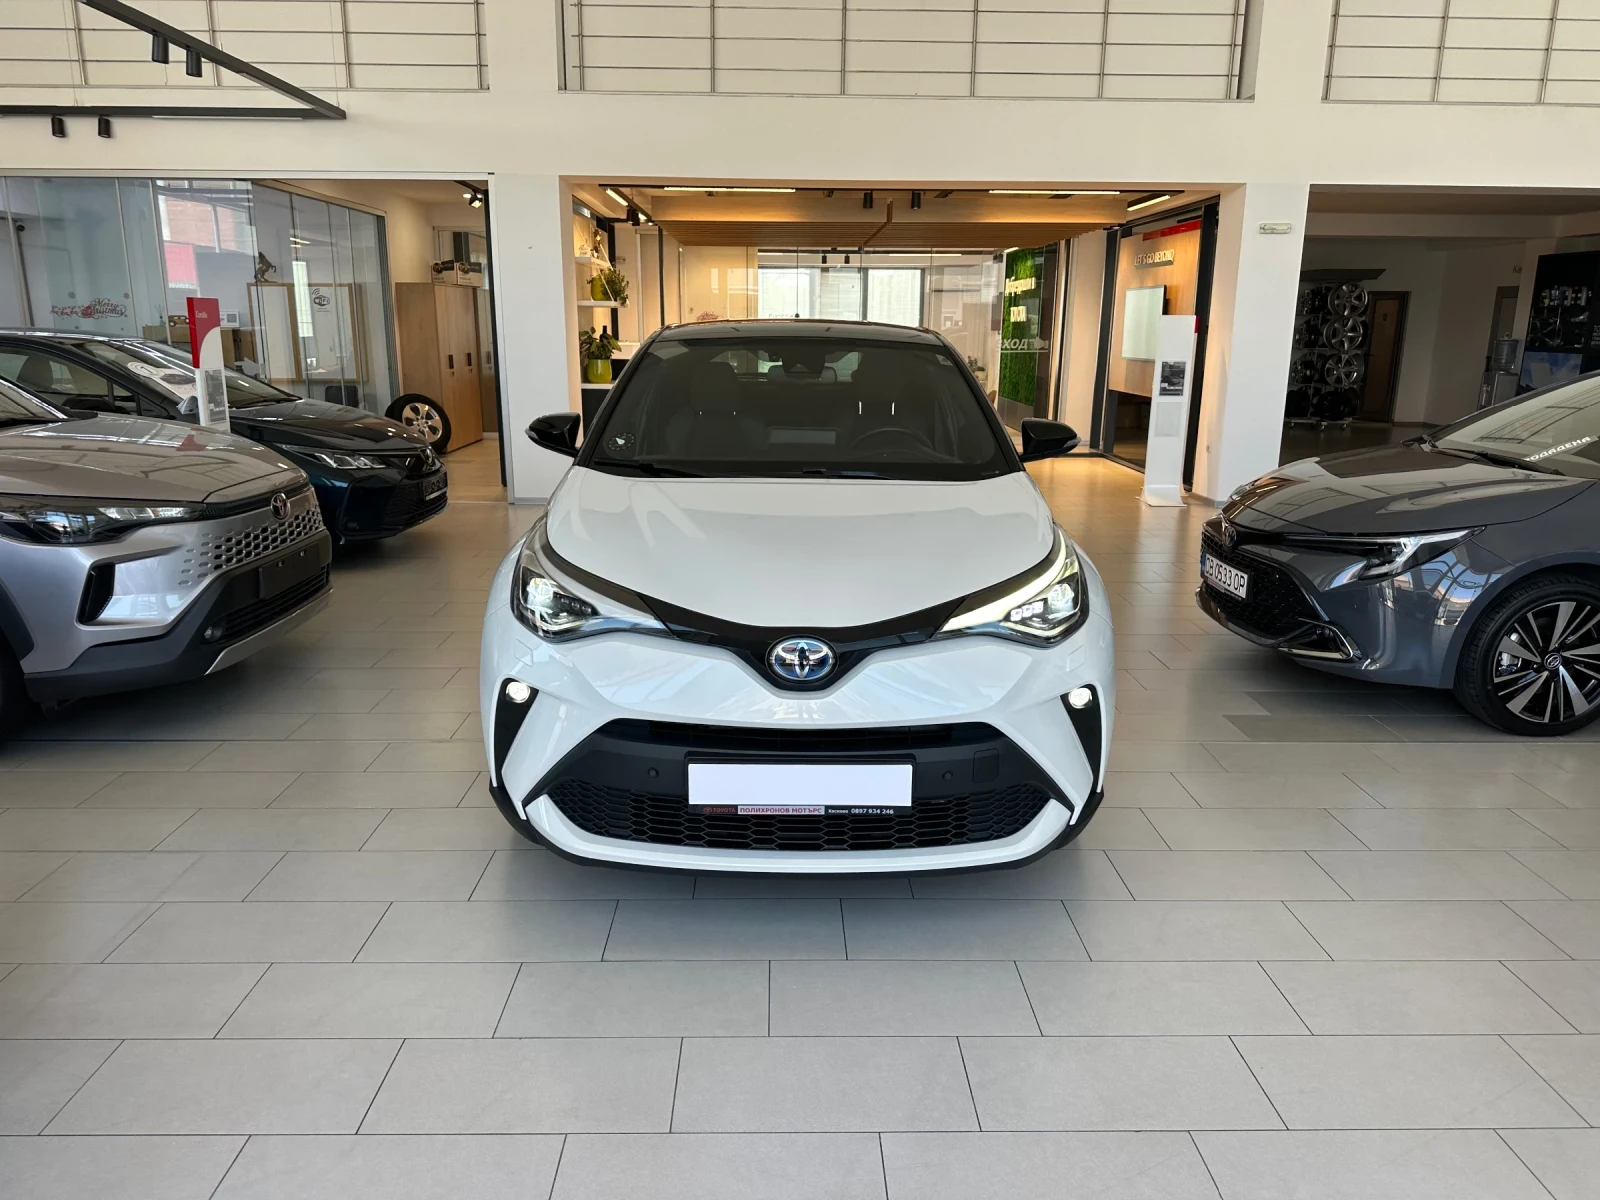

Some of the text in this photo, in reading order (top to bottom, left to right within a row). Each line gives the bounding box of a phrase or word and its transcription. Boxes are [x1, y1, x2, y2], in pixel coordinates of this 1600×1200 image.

[1147, 252, 1155, 264] GO
[1215, 562, 1232, 587] 0533
[1233, 572, 1246, 593] OP
